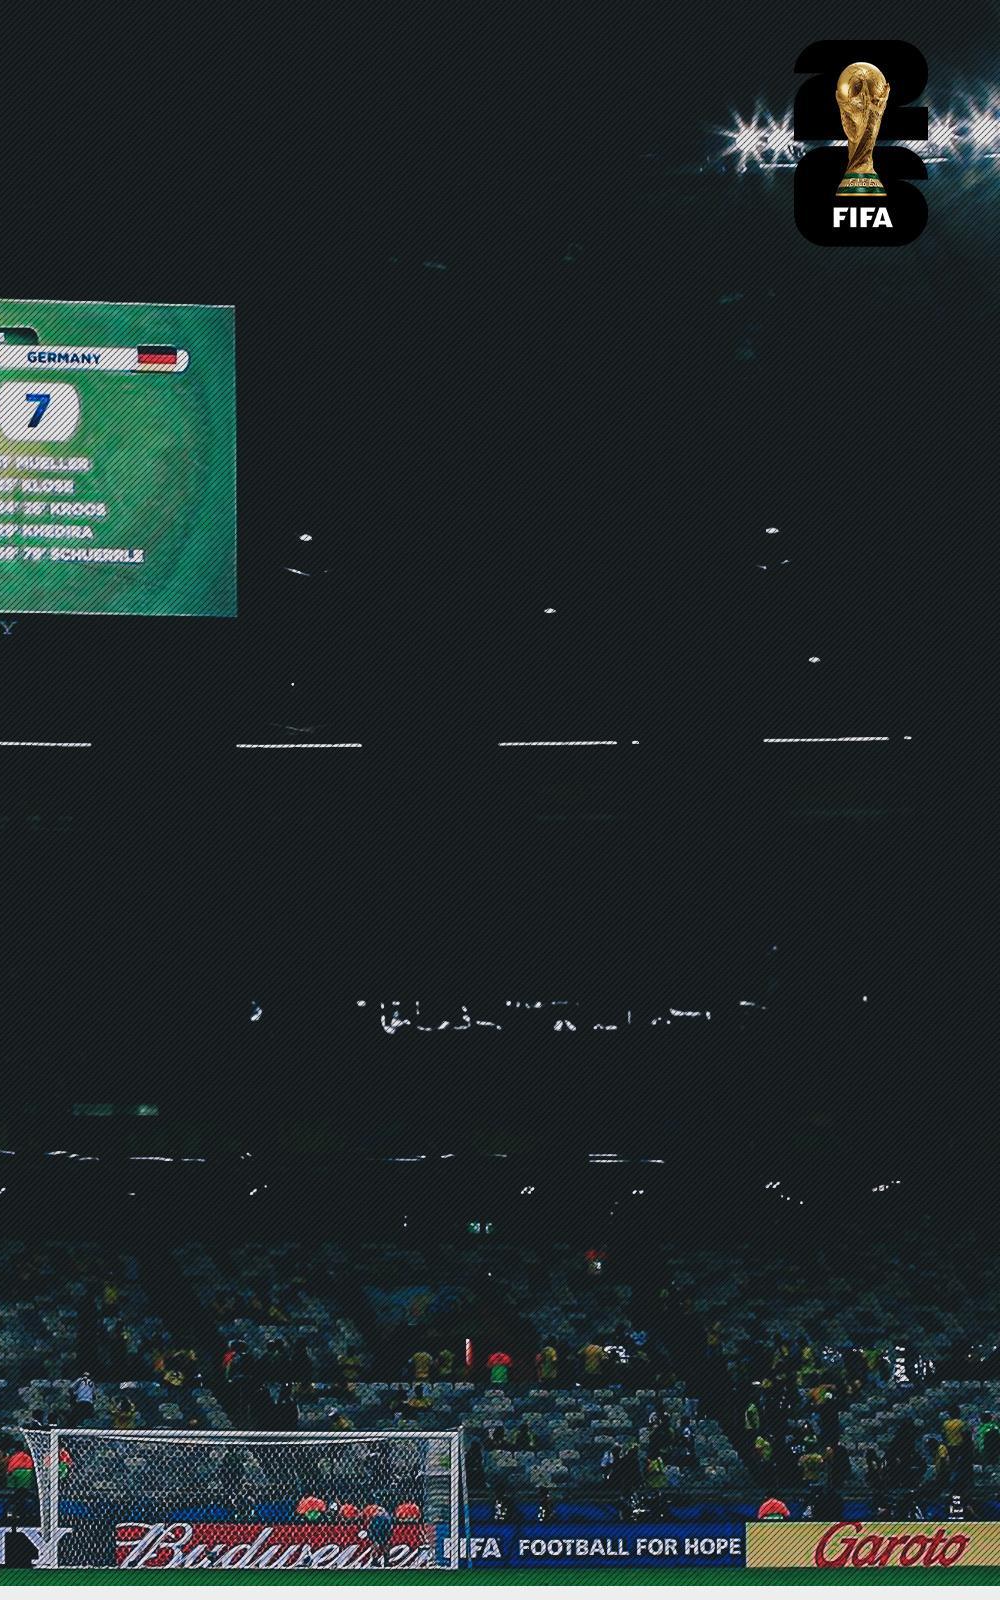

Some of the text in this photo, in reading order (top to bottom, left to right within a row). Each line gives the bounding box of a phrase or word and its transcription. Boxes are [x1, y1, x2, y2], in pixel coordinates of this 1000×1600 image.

[27, 352, 102, 365] GERMANY
[25, 393, 52, 428] 7
[16, 456, 91, 472] MUELLER
[21, 479, 75, 494] KLOSE
[50, 501, 107, 517] KROOS
[22, 524, 94, 540] KHEDIRA
[50, 547, 145, 564] SCHUERRLE
[519, 1537, 742, 1557] FOOTBALL FOR HOPE
[814, 1521, 970, 1569] Garoto
